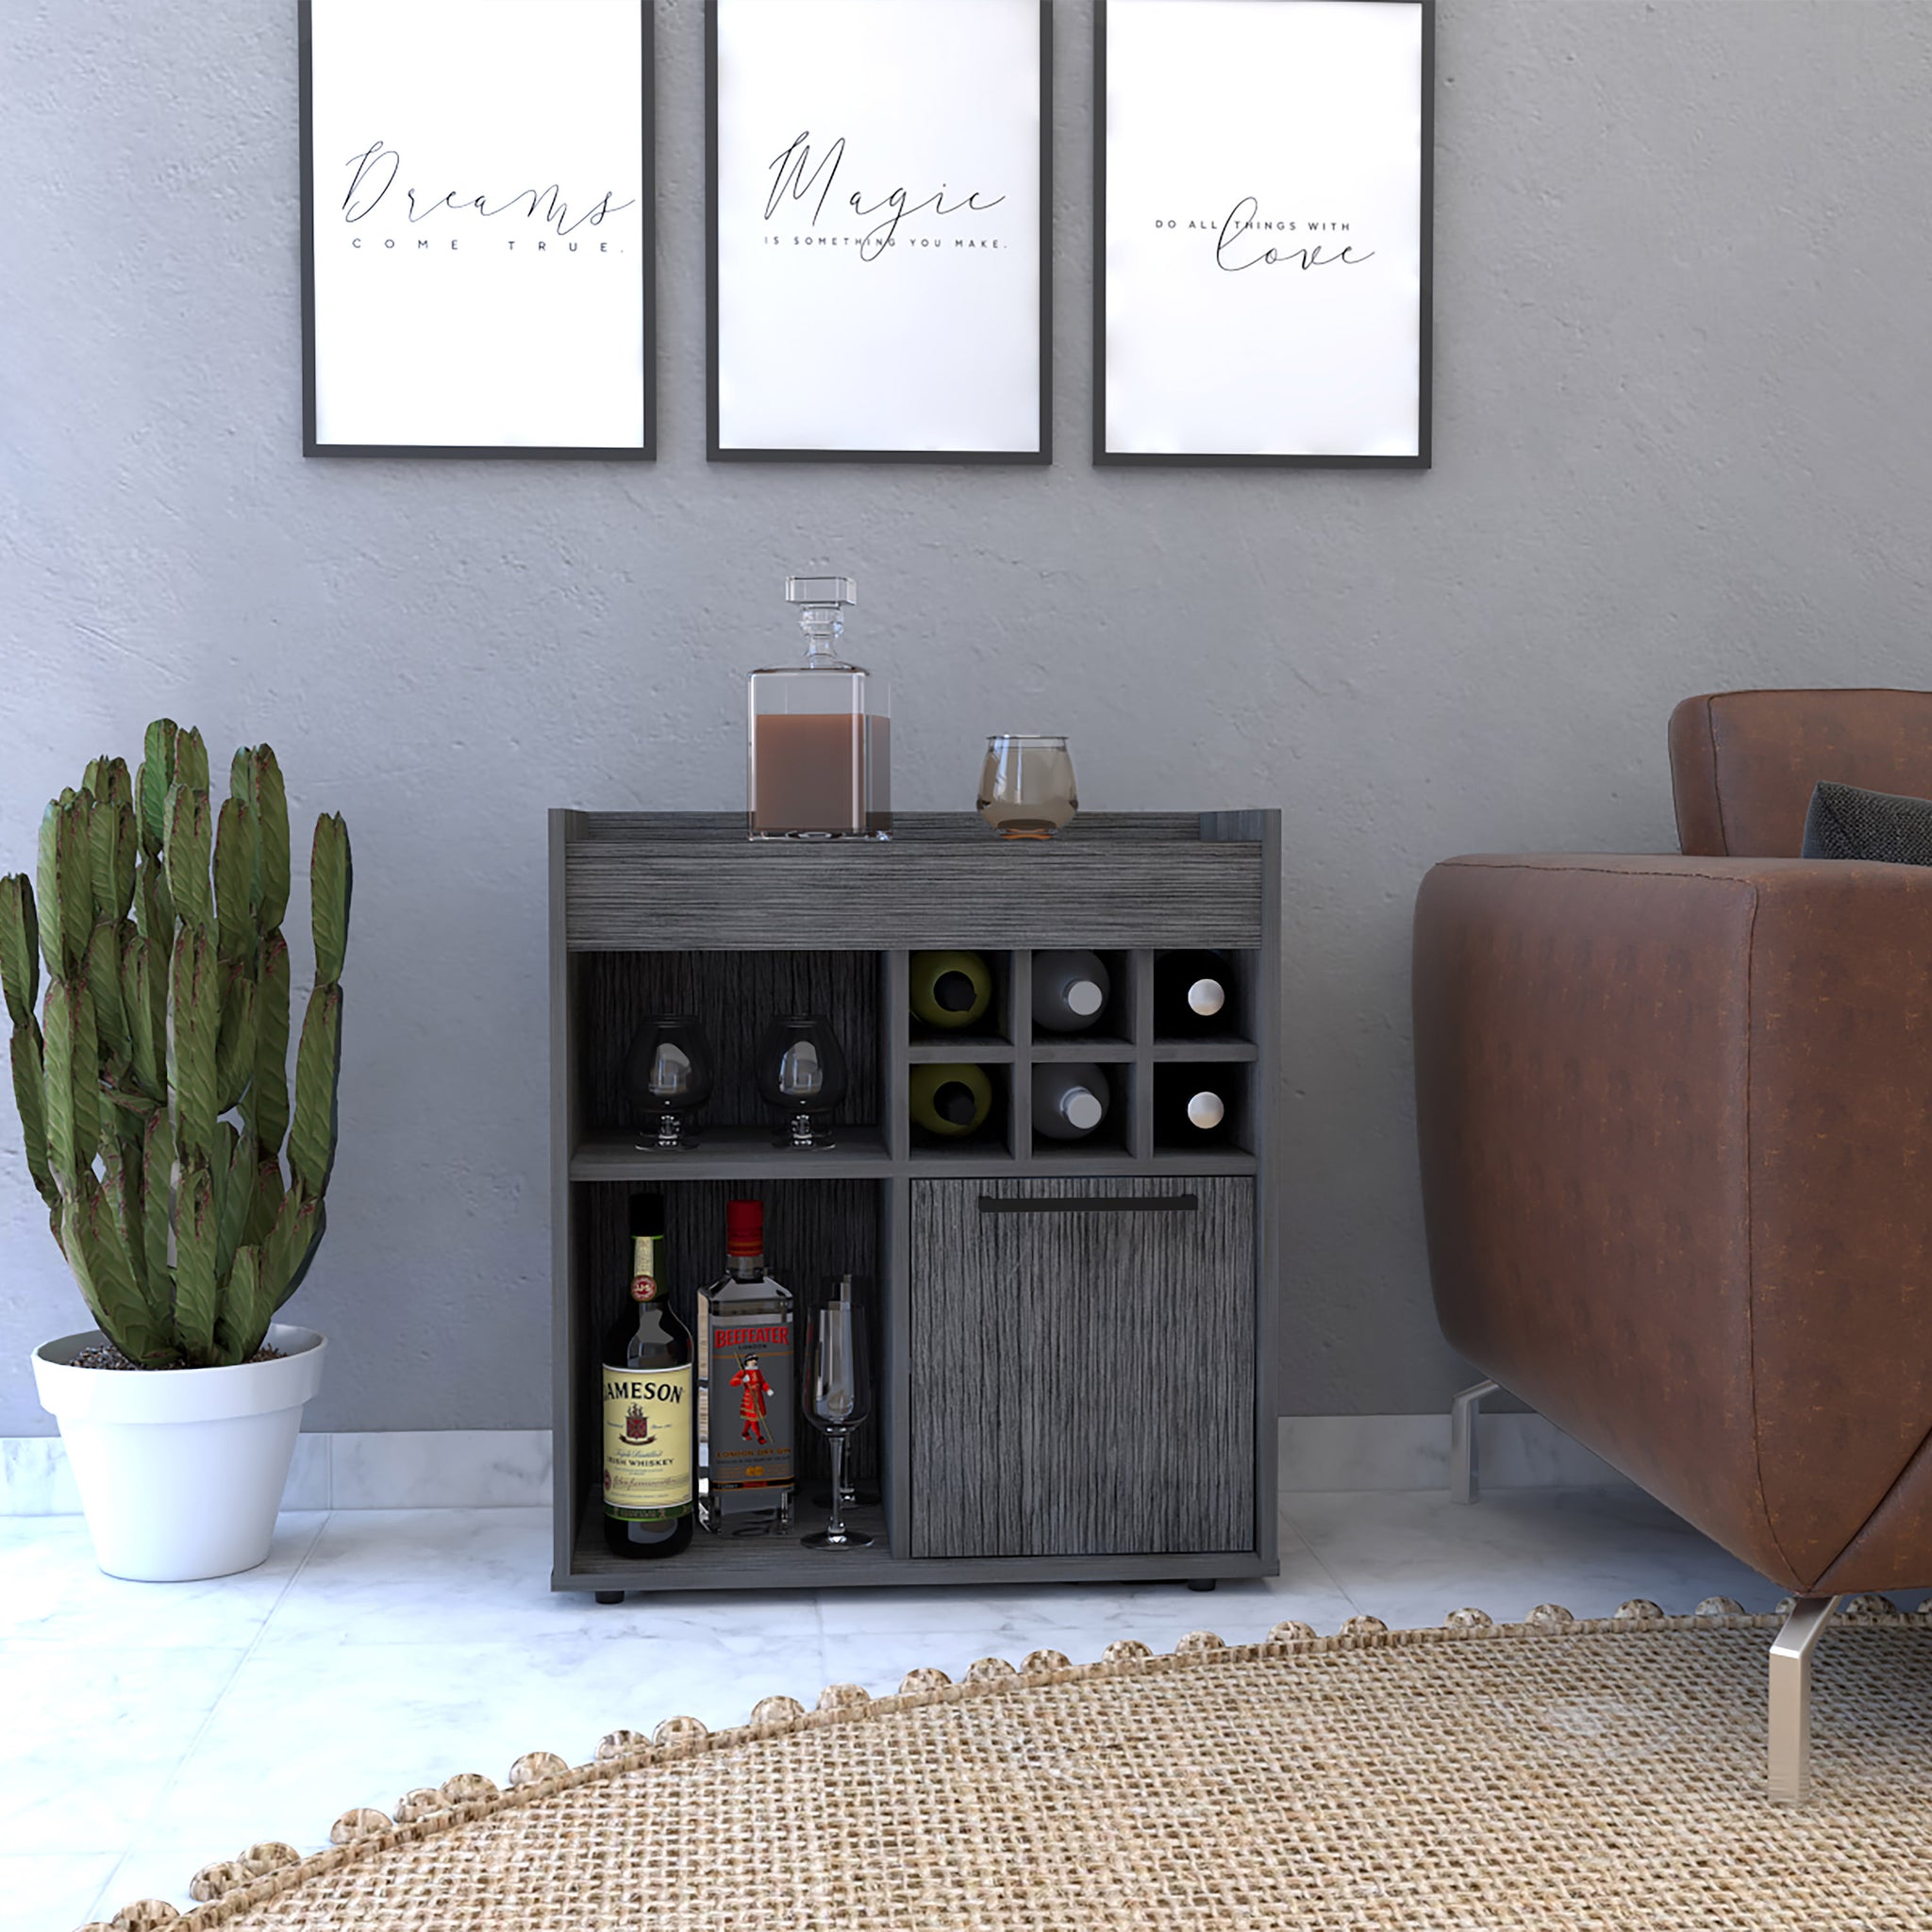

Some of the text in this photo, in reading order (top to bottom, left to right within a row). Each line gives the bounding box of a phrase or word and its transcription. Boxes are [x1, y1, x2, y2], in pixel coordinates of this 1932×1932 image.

[342, 141, 636, 236] Dreams
[764, 130, 1007, 262] Magic
[1155, 219, 1350, 231] DO ALL THINGS WITH
[352, 239, 458, 251] COME
[764, 236, 1008, 249] IS SOMETHING YOU MAKE.
[715, 1326, 789, 1348] BEEFEATER
[628, 1458, 675, 1467] WHISKEY
